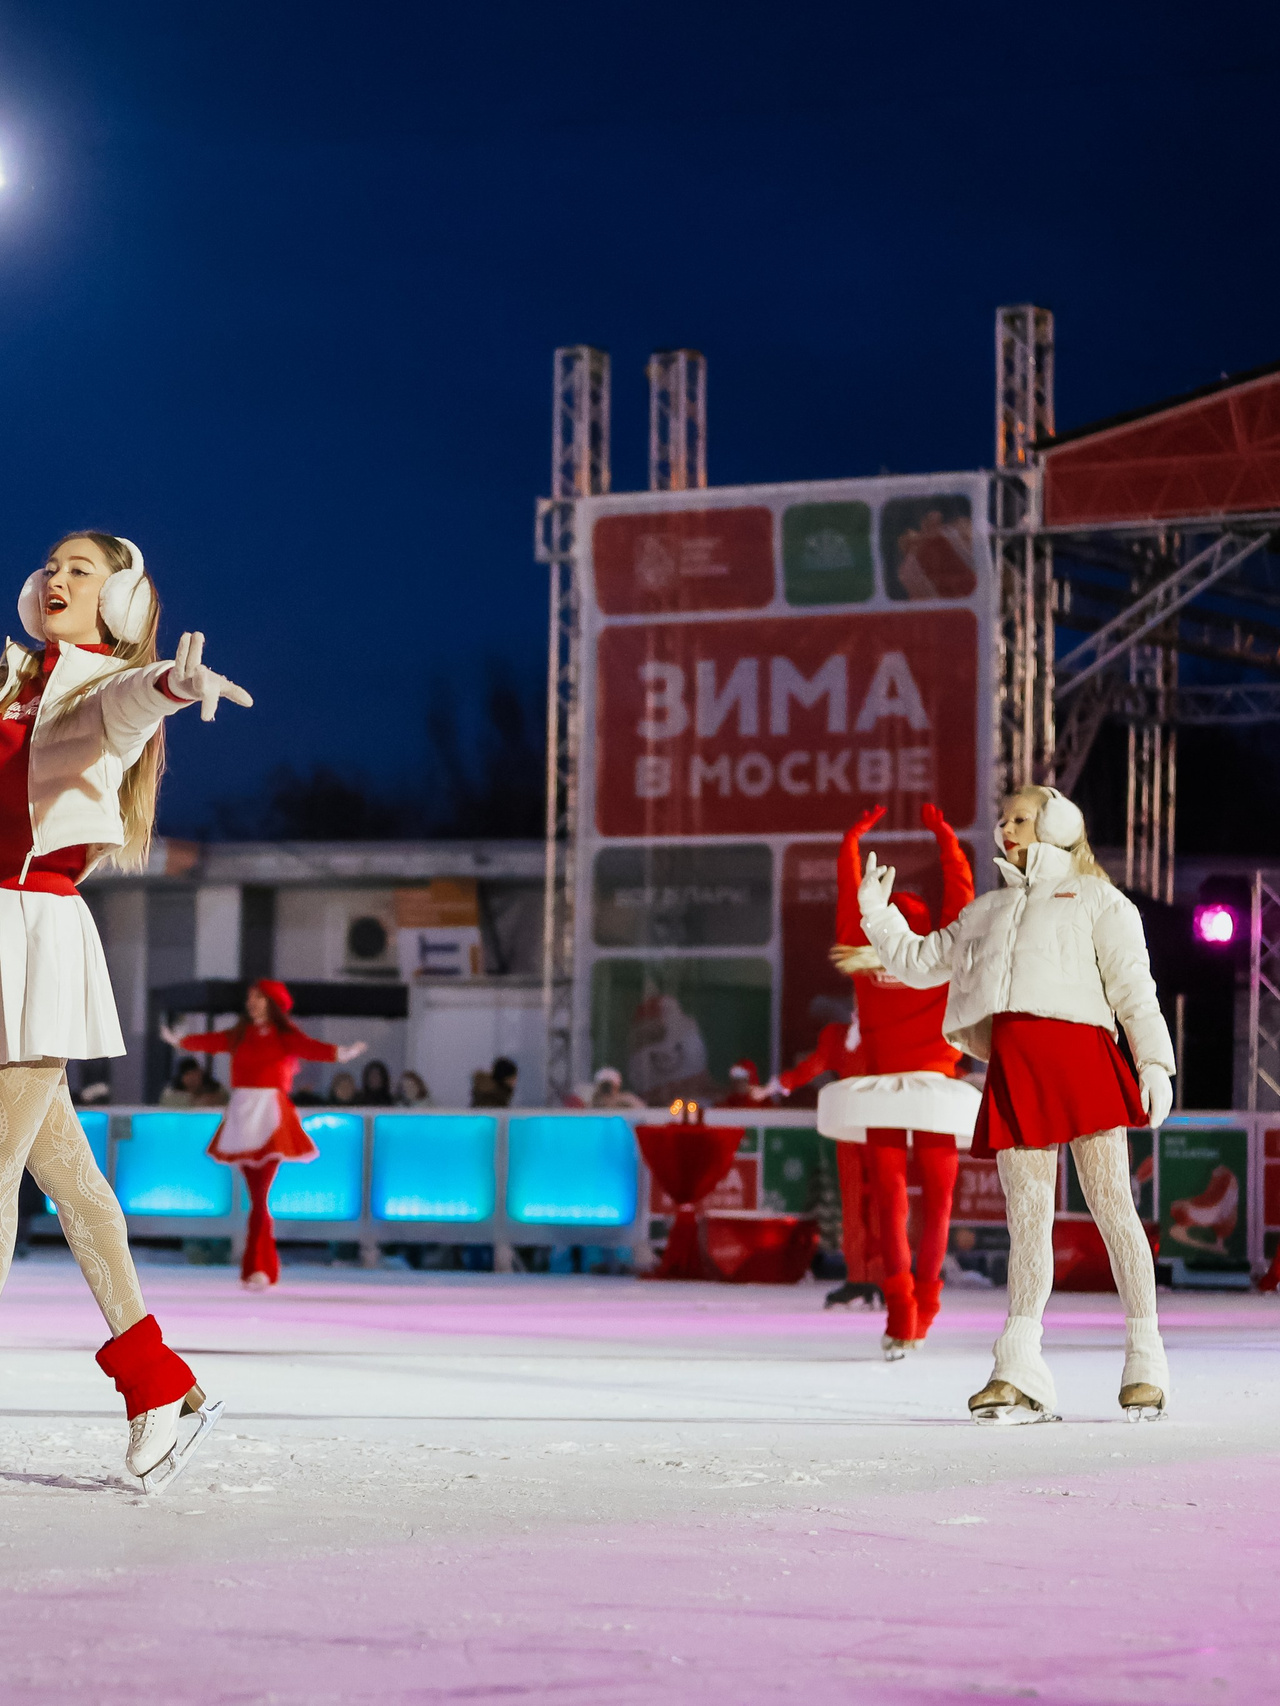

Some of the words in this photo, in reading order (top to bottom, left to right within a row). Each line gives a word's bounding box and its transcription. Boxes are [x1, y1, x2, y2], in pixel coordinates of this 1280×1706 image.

[637, 651, 931, 740] ЗИМА
[635, 754, 672, 798] В
[690, 746, 934, 798] МОСКВЕ
